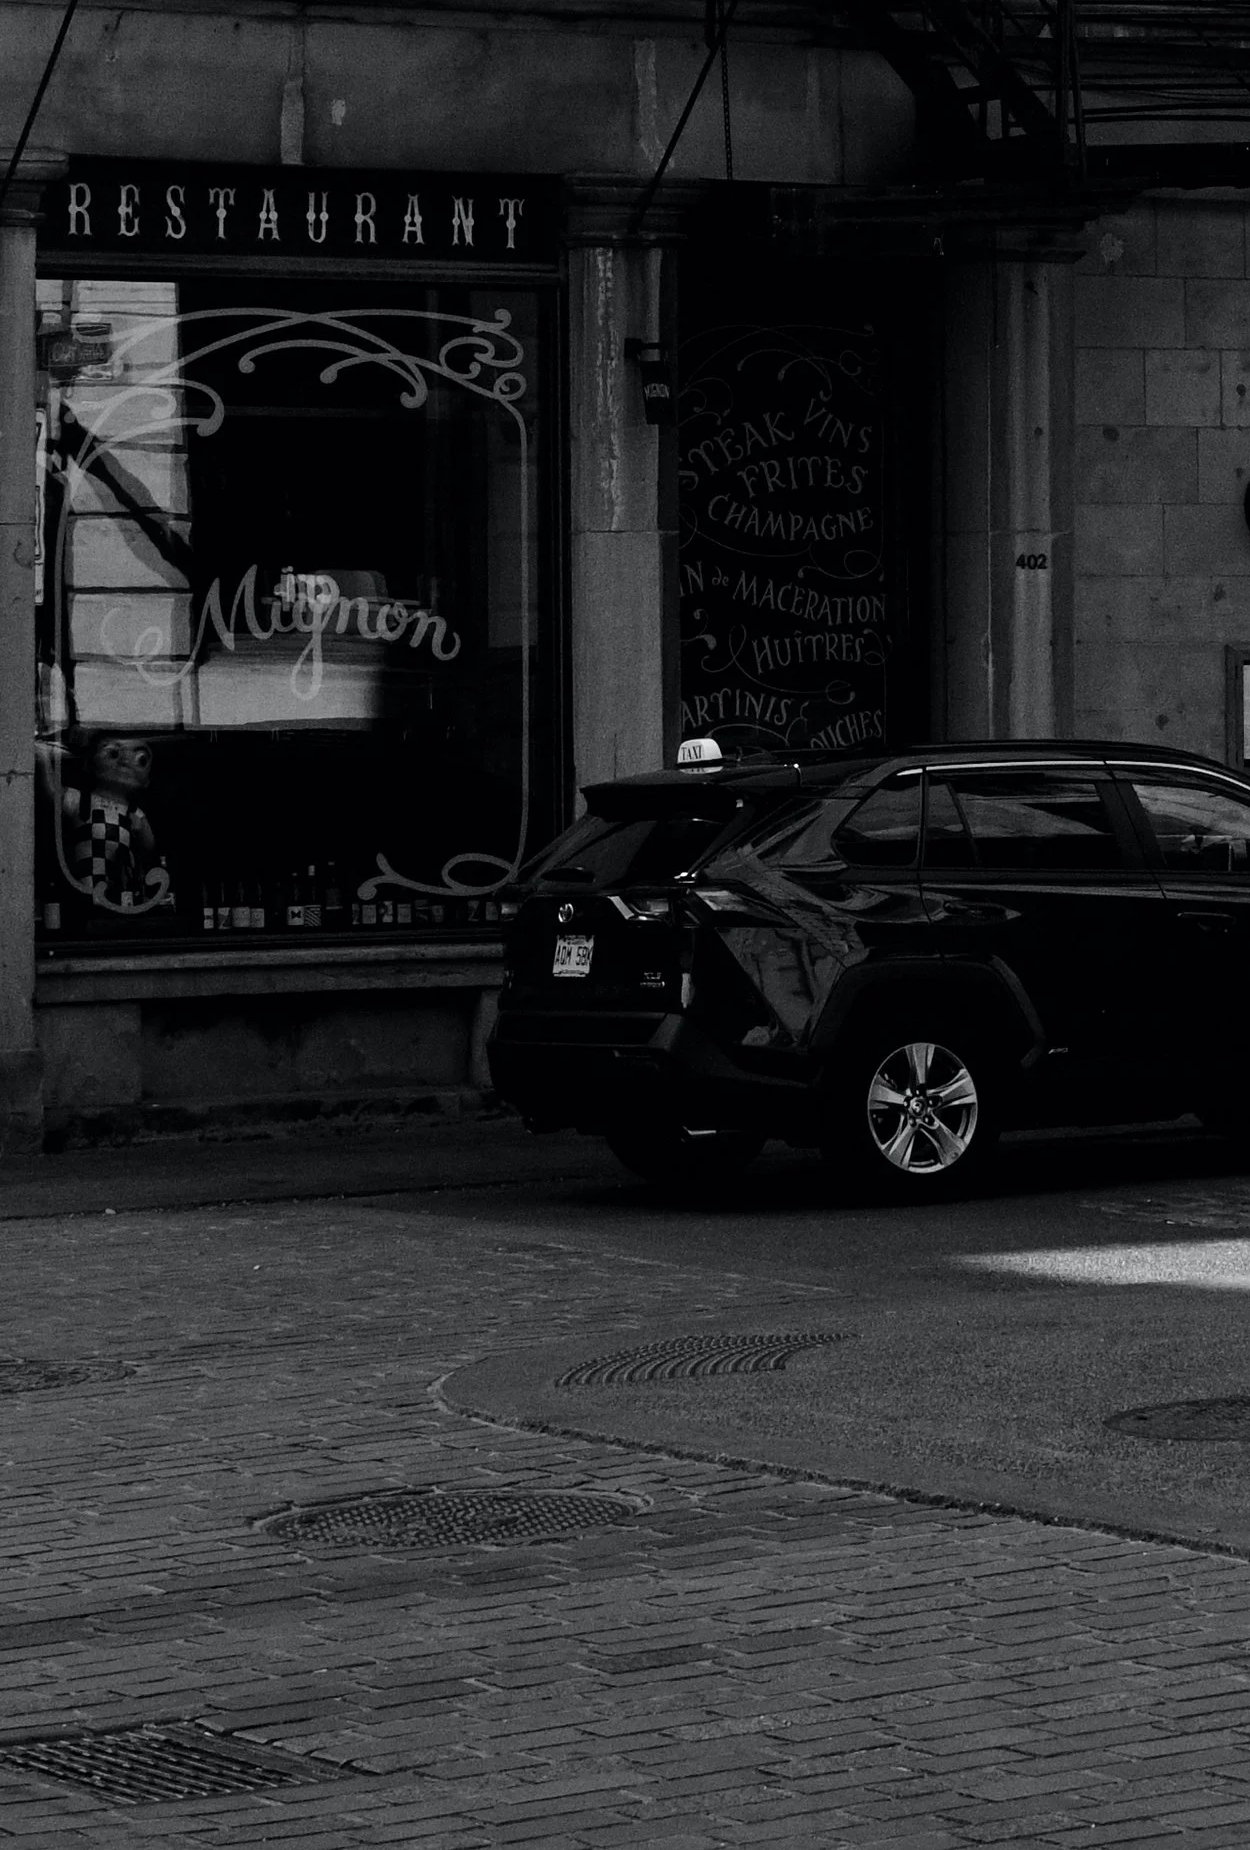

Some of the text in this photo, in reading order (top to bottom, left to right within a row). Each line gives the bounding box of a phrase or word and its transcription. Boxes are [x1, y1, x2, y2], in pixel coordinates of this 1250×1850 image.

[67, 182, 526, 250] RESTAURANT
[803, 398, 873, 454] VINS
[736, 455, 869, 498] FRITES
[708, 493, 875, 541] CHAMPAGNE
[711, 565, 730, 587] de
[1015, 553, 1047, 570] 402
[150, 562, 462, 700] Mignon
[681, 688, 792, 730] ARTINIS
